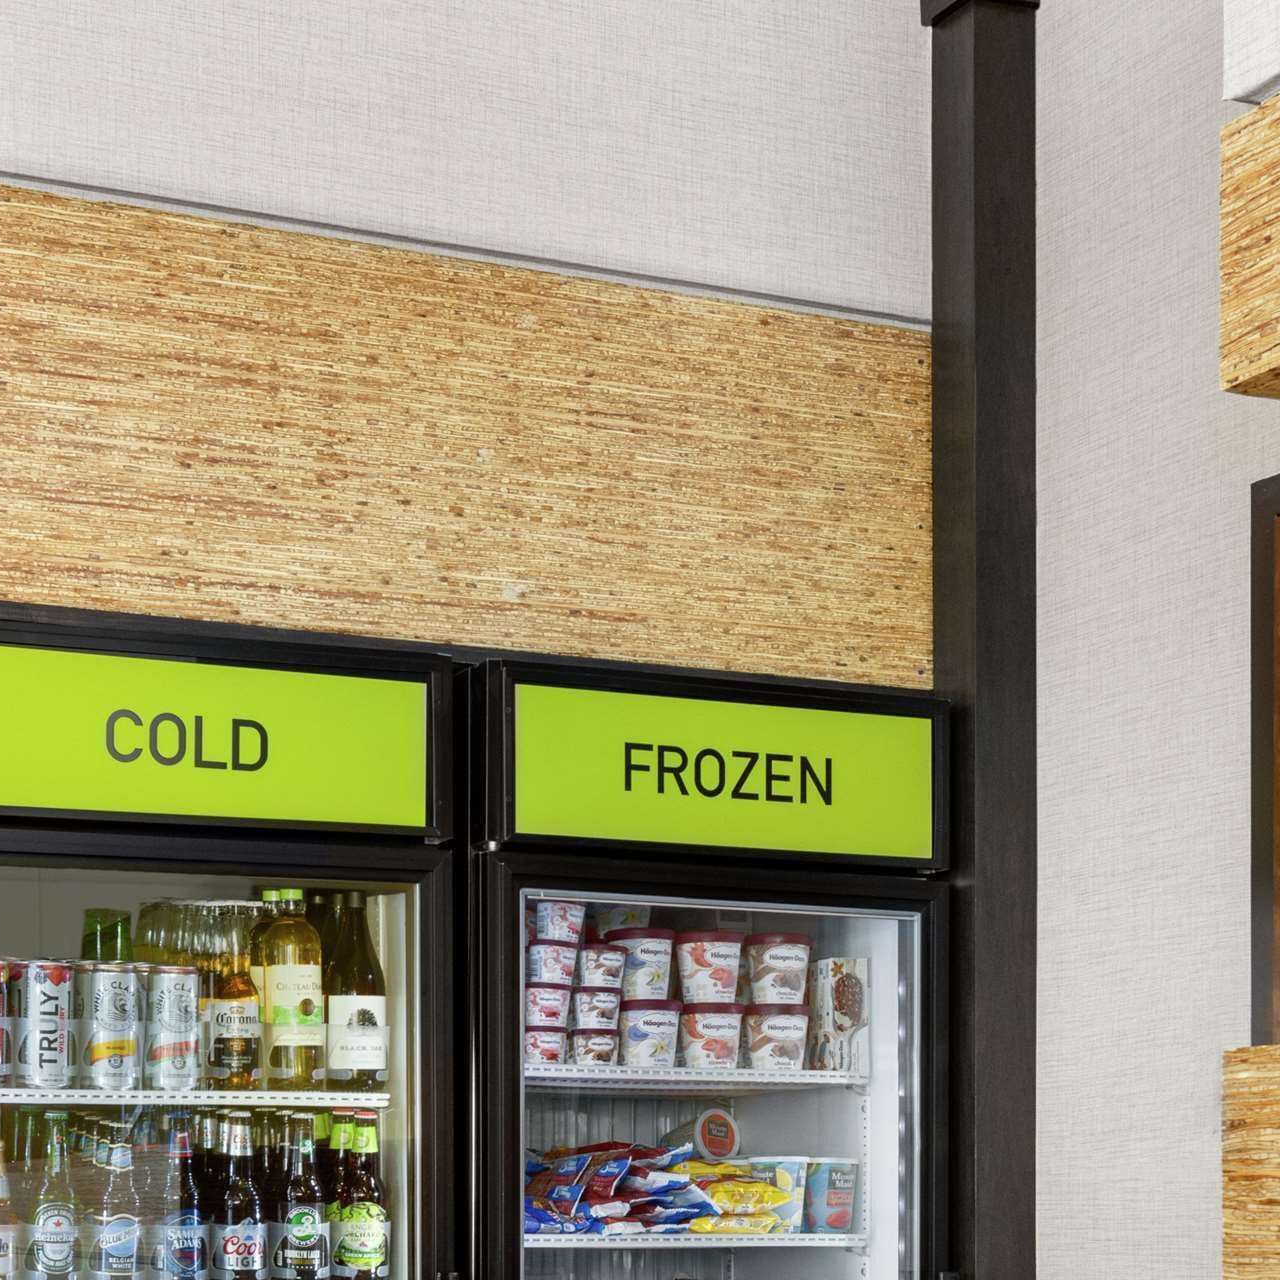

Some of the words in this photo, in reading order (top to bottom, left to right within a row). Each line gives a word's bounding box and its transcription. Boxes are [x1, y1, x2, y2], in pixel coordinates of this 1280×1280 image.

[105, 706, 269, 774] COLD
[623, 740, 834, 806] FROZEN
[39, 990, 59, 1069] TRULY
[215, 1012, 257, 1025] Corona
